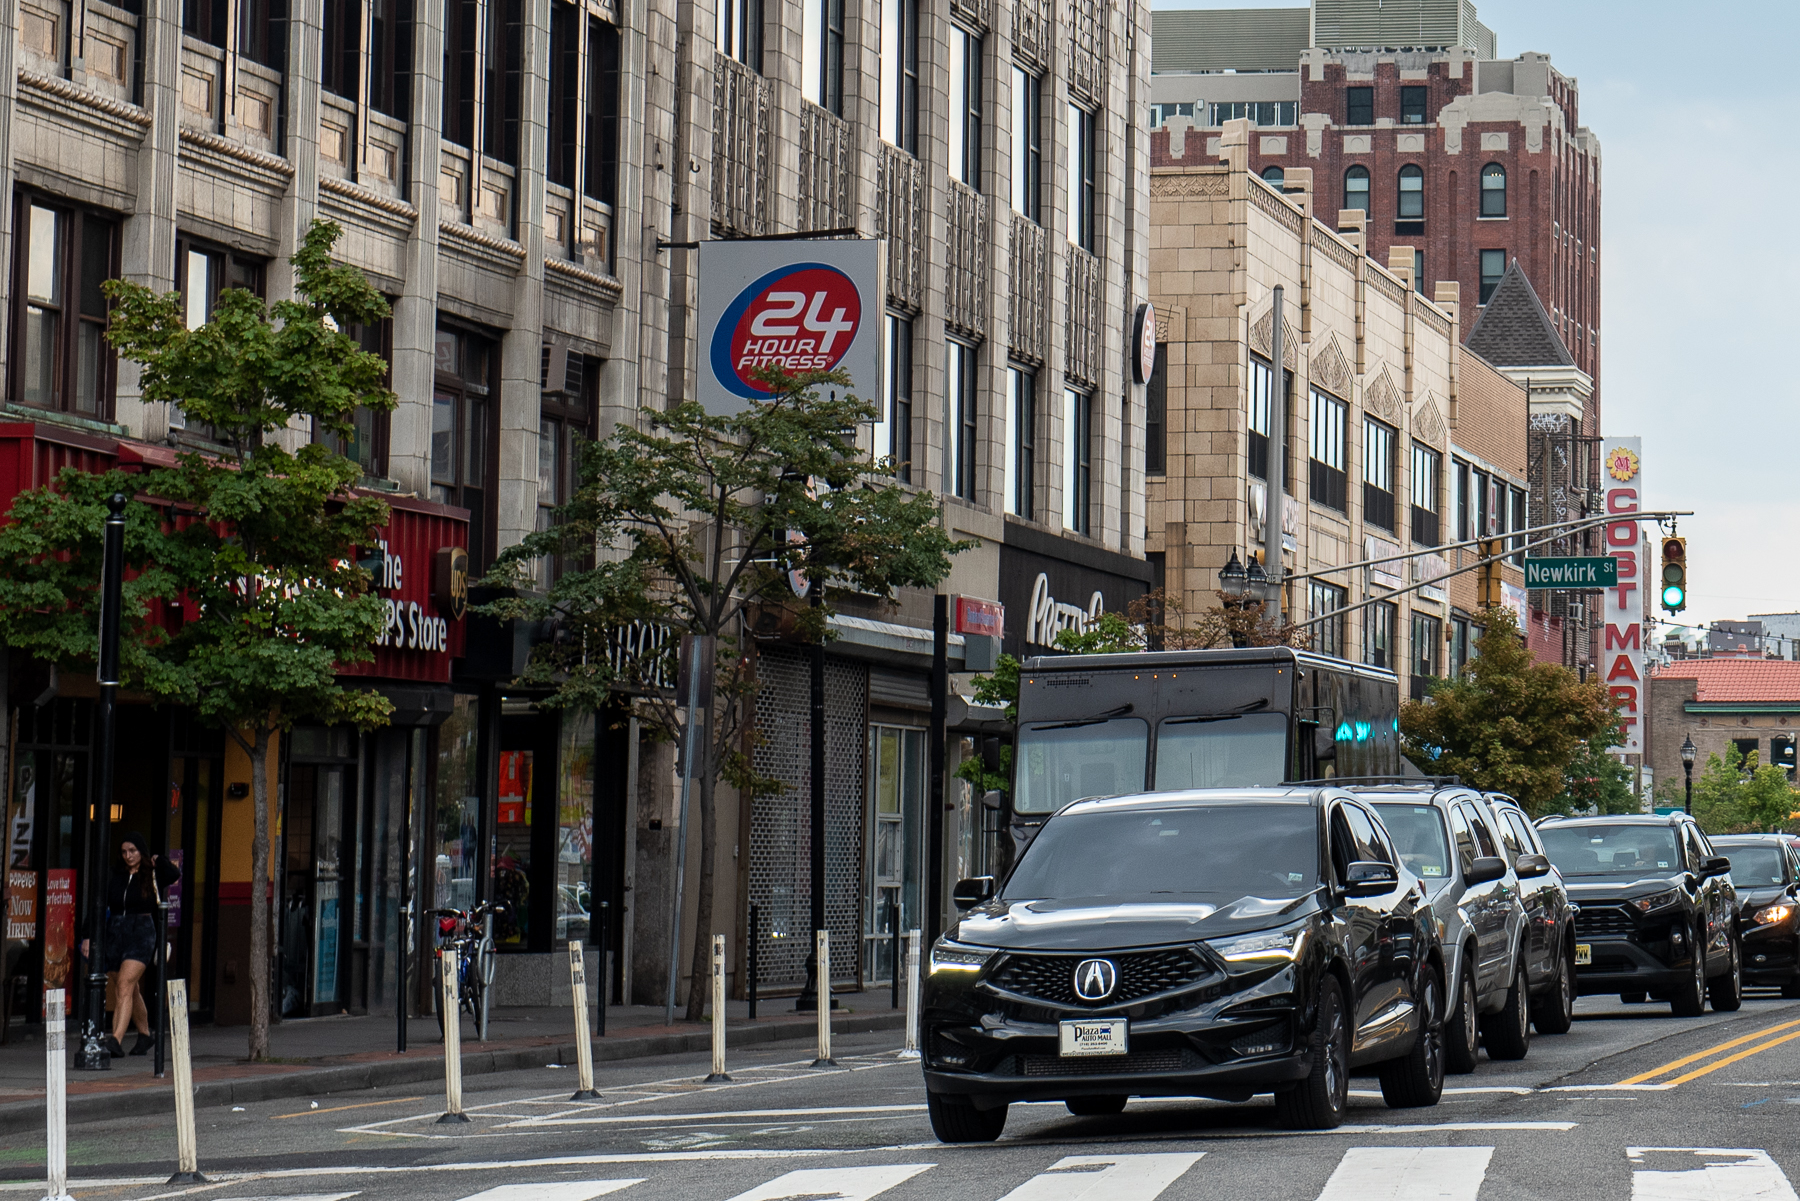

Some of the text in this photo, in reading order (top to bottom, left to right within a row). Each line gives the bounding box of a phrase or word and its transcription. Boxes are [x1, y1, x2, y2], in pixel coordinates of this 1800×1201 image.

[750, 291, 854, 354] 24
[742, 338, 816, 355] HOUR
[737, 355, 829, 371] FITNESS
[1605, 487, 1638, 610] COST
[1528, 561, 1614, 584] Newkirk St
[450, 569, 467, 610] ups
[409, 601, 447, 653] Store
[60, 877, 70, 890] that
[46, 892, 73, 905] erfect bite
[1074, 1026, 1100, 1042] Plaza
